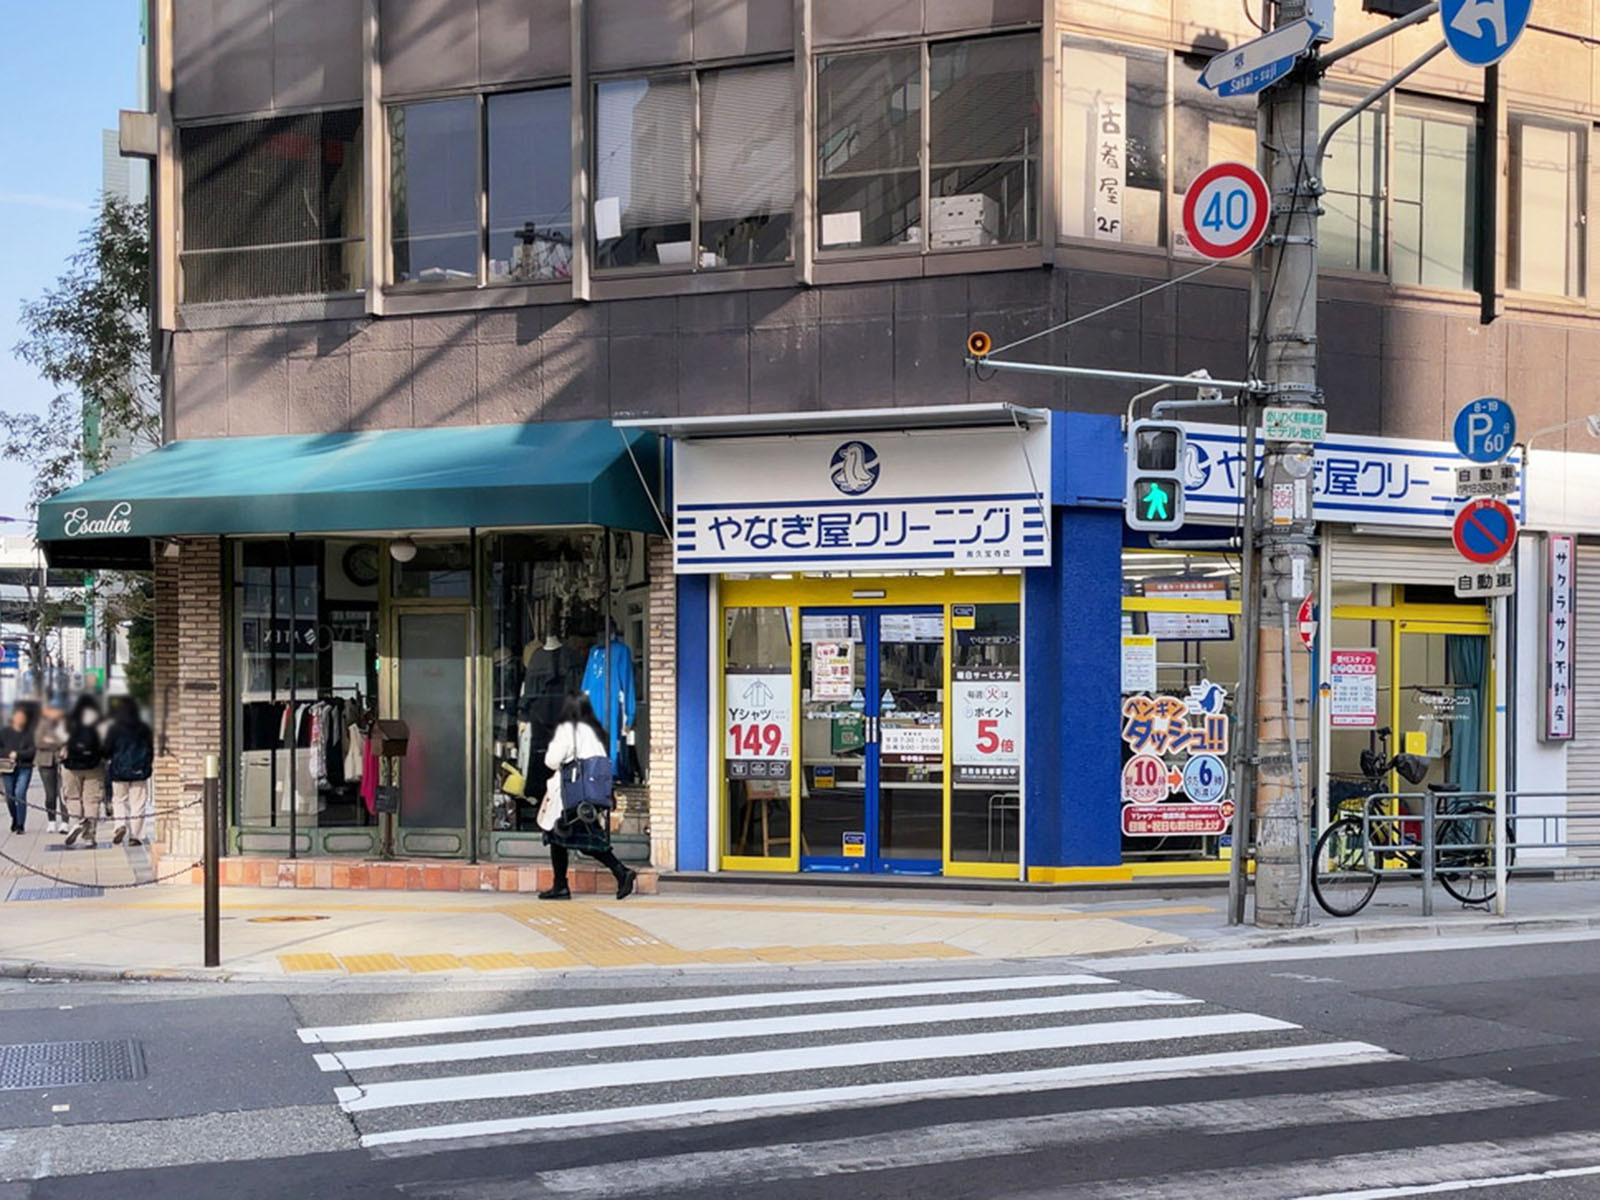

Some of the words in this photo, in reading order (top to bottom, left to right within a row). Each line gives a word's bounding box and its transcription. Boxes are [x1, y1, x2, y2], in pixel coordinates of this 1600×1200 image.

[1100, 109, 1121, 204] 古着屋
[1202, 189, 1248, 232] 40
[1097, 217, 1120, 233] 2F
[1266, 425, 1322, 440] モデル地区
[1468, 413, 1493, 455] P
[1459, 466, 1513, 482] 自動車
[64, 502, 132, 537] Escalier
[708, 507, 1011, 550] やなぎ屋クリーニング
[1458, 573, 1512, 591] 自動車
[1554, 552, 1567, 721] サクラサク不動産
[728, 707, 772, 720] Yシャツ
[974, 708, 1012, 718] ポイント
[1126, 701, 1184, 717] ペンギン
[976, 720, 1014, 754] 5倍
